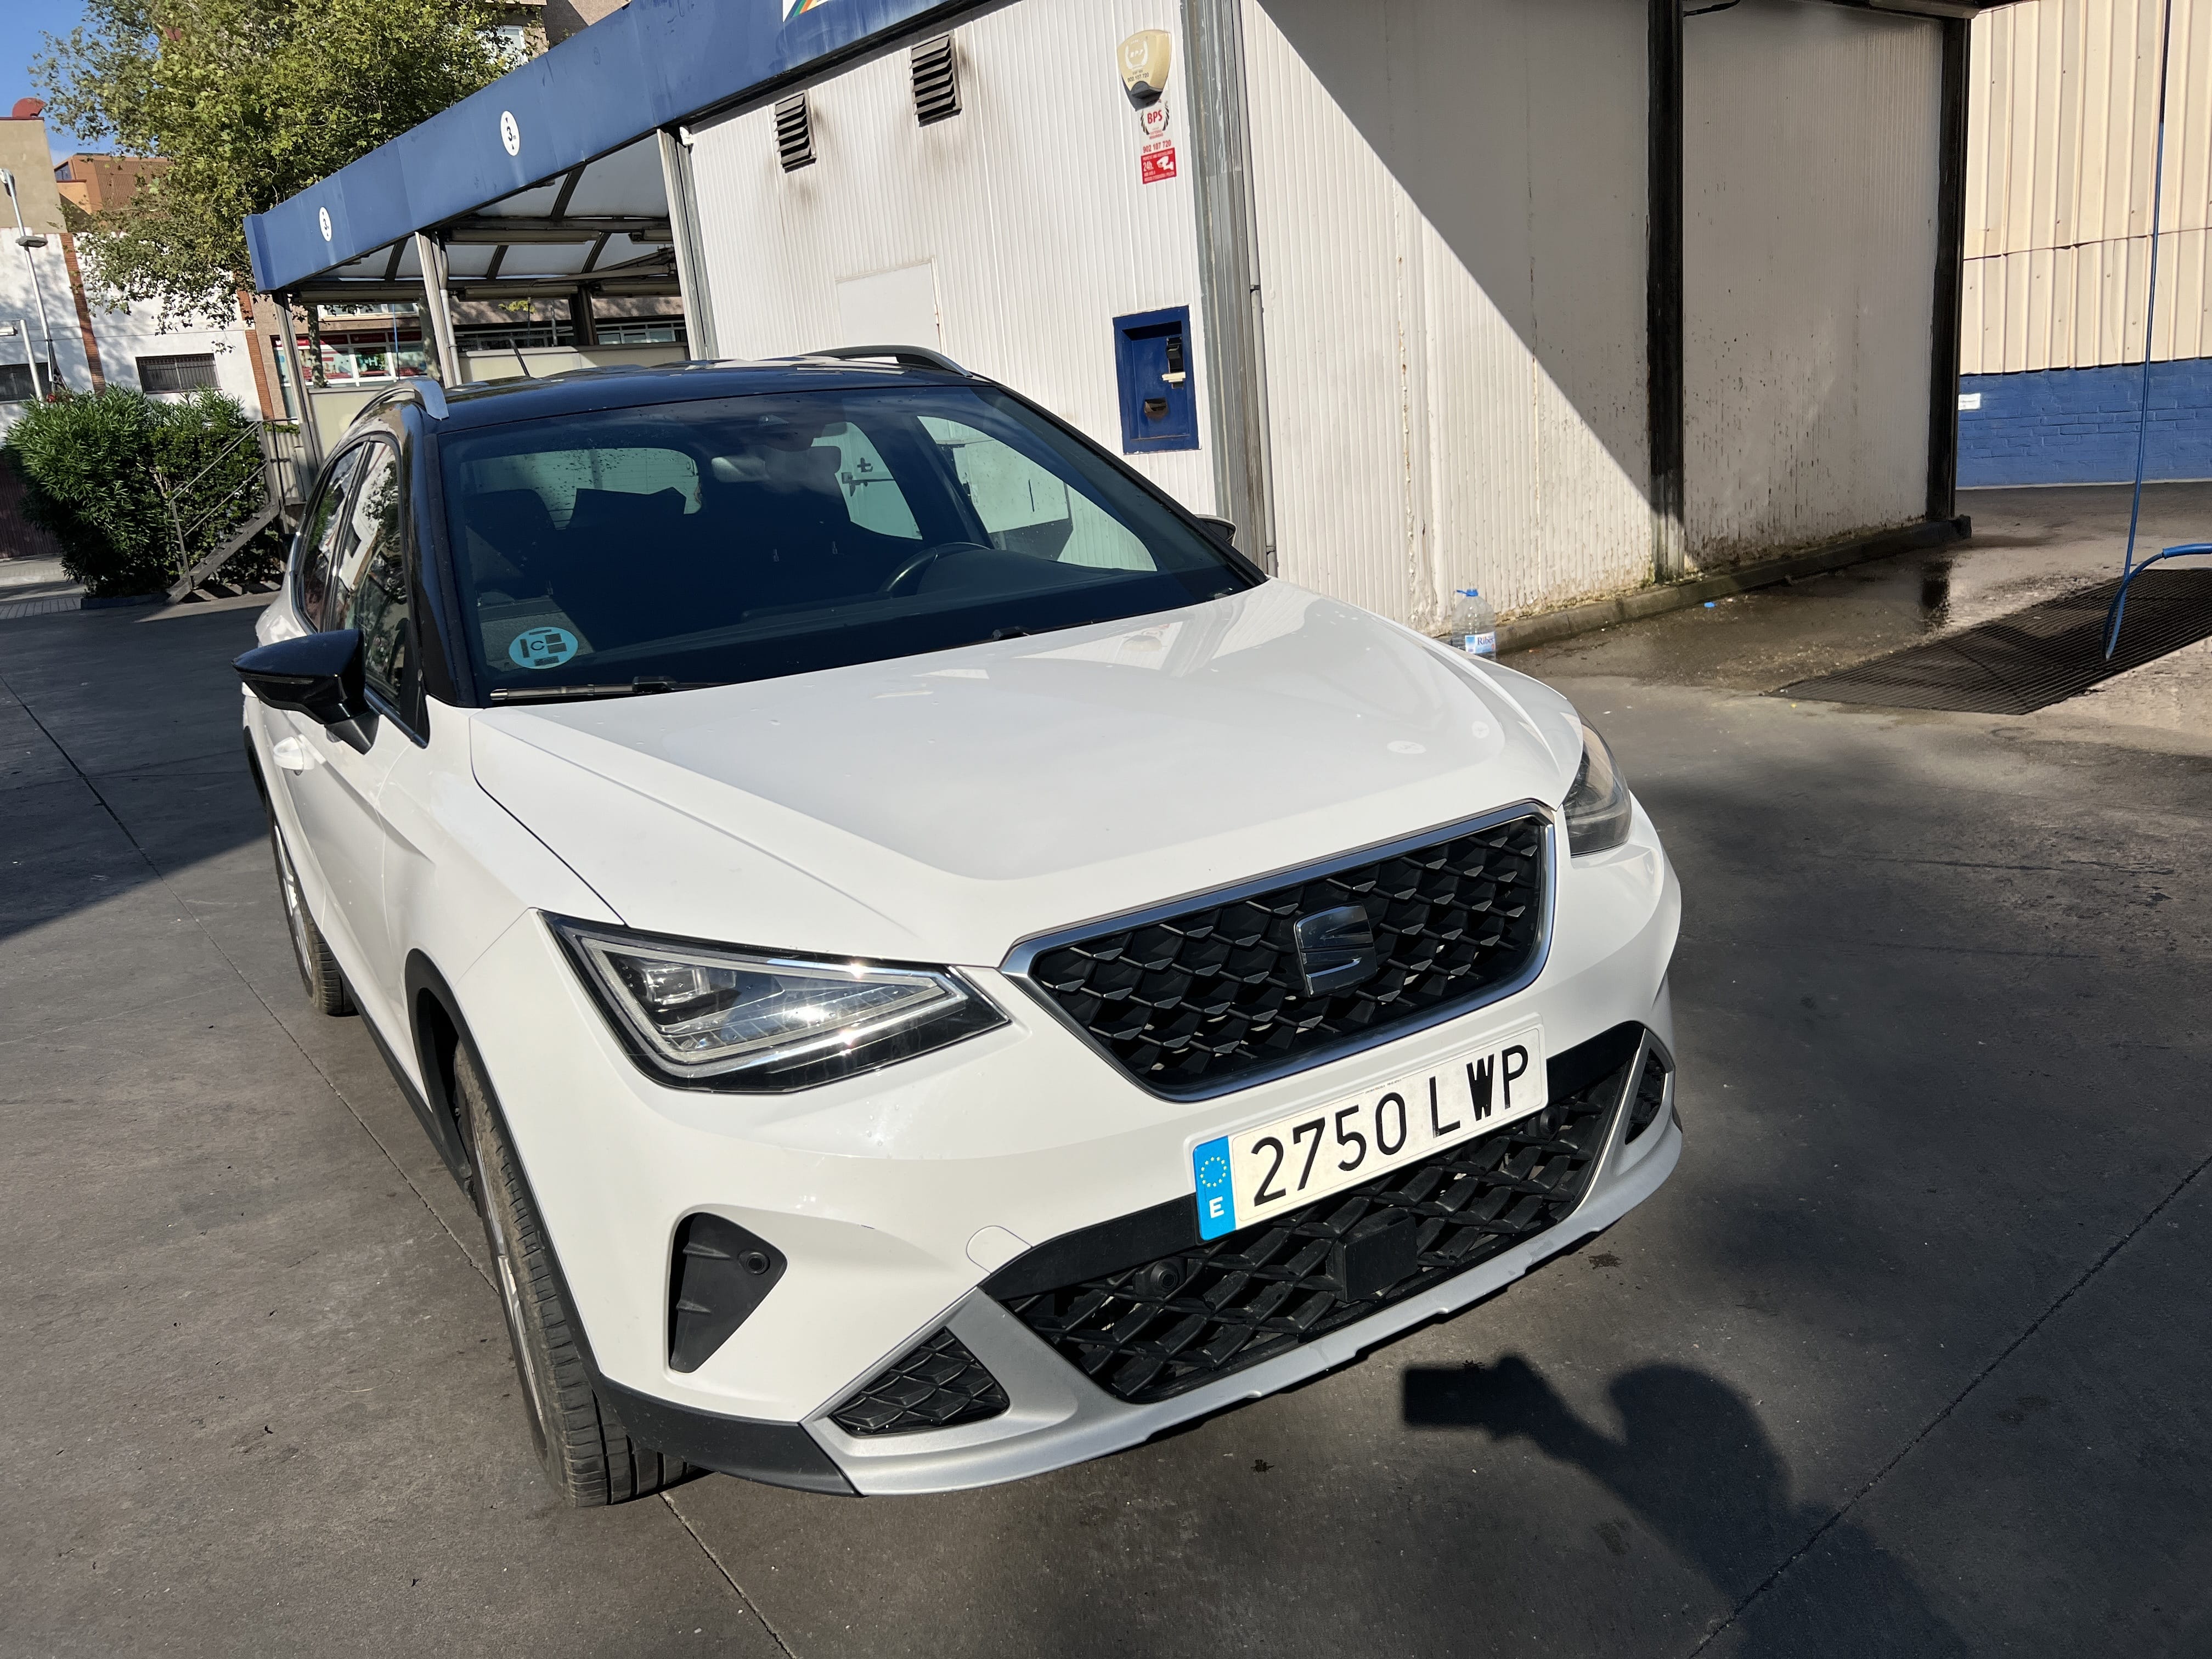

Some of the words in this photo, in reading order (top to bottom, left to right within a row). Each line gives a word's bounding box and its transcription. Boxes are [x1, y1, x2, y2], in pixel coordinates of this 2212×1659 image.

[1147, 110, 1163, 124] BPS
[507, 126, 513, 142] 3
[1143, 144, 1152, 153] 902
[1153, 142, 1161, 150] 107
[1163, 139, 1171, 148] 720
[531, 640, 545, 651] C
[1251, 1092, 1407, 1207] 2750
[1429, 1045, 1528, 1138] LWP
[1209, 1196, 1224, 1218] E
